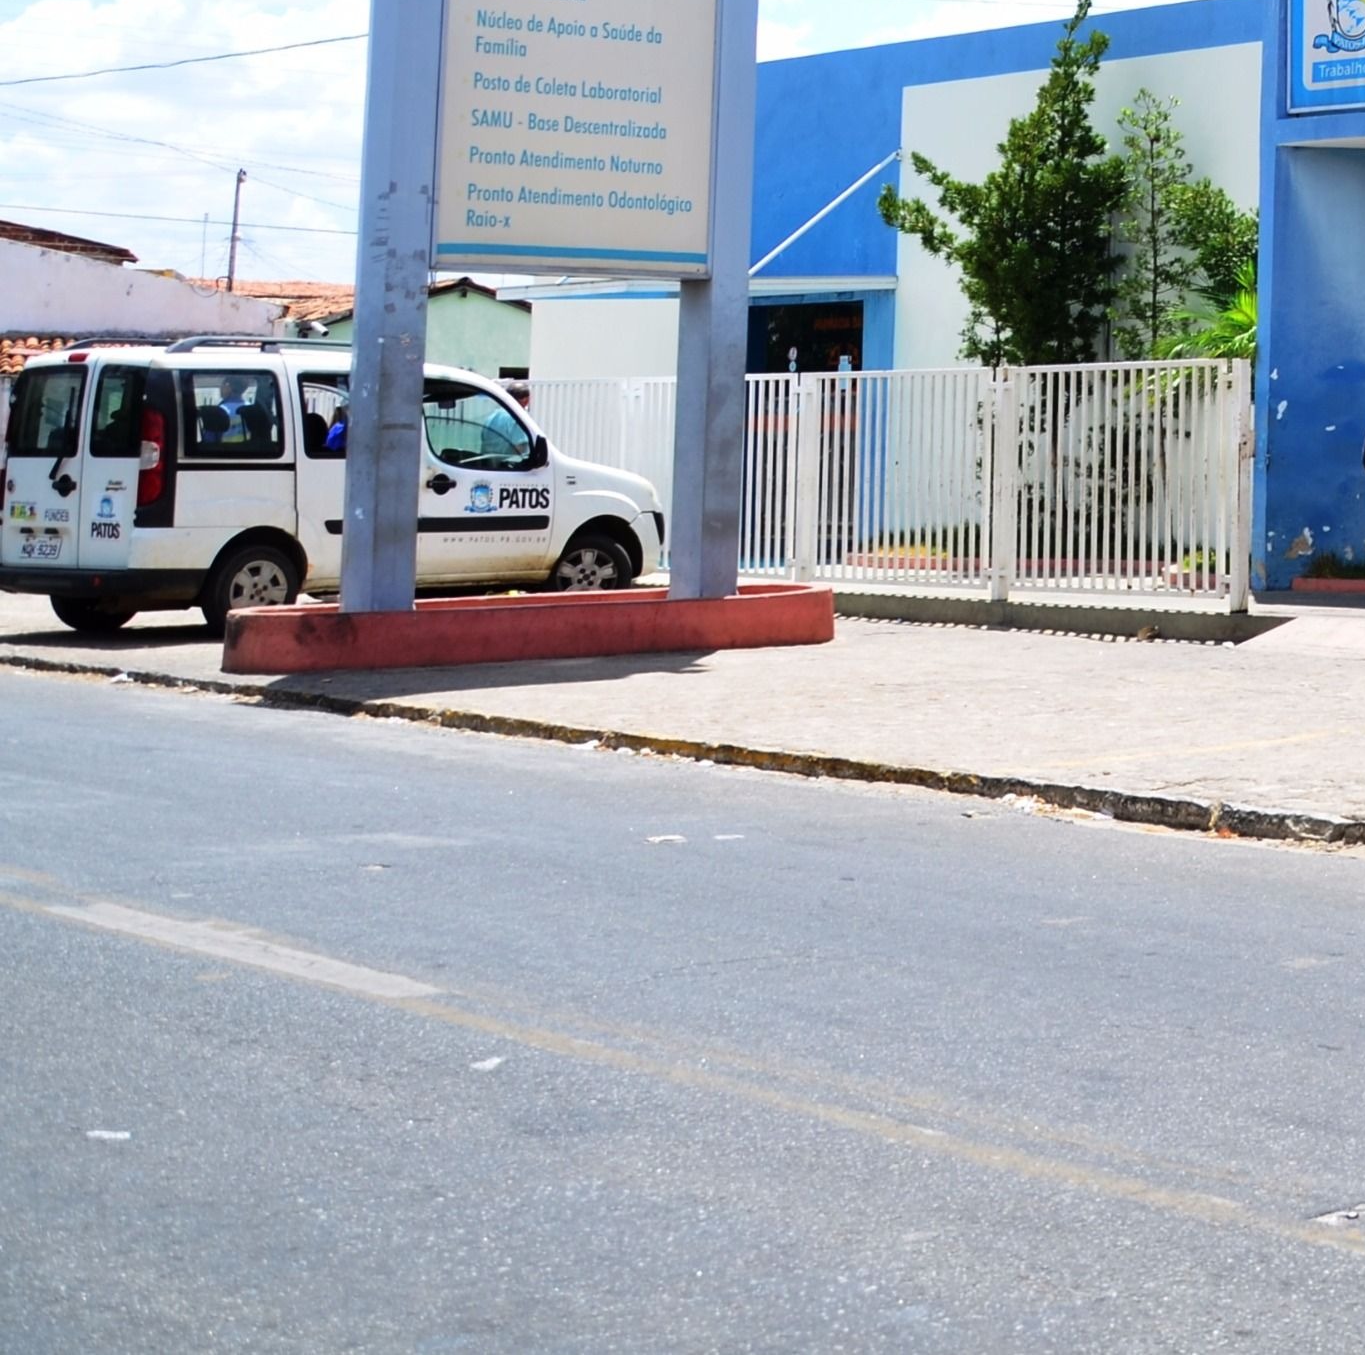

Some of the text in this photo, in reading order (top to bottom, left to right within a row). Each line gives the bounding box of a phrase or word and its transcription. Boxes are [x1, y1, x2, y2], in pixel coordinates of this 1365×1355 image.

[476, 10, 662, 44] Núcleo de Apoio a Saúde da
[475, 35, 527, 57] Família
[473, 72, 662, 104] Posto de Coleta Laboratorial
[471, 109, 513, 128] SAMU
[528, 113, 559, 132] Base
[564, 115, 667, 140] Descentralizada
[469, 146, 663, 175] Pronto Atendimento Noturno
[467, 183, 693, 216] Pronto Atendimento Odontológico
[466, 209, 511, 228] Raio-x
[499, 488, 550, 509] PATOS
[91, 522, 120, 539] PATOS
